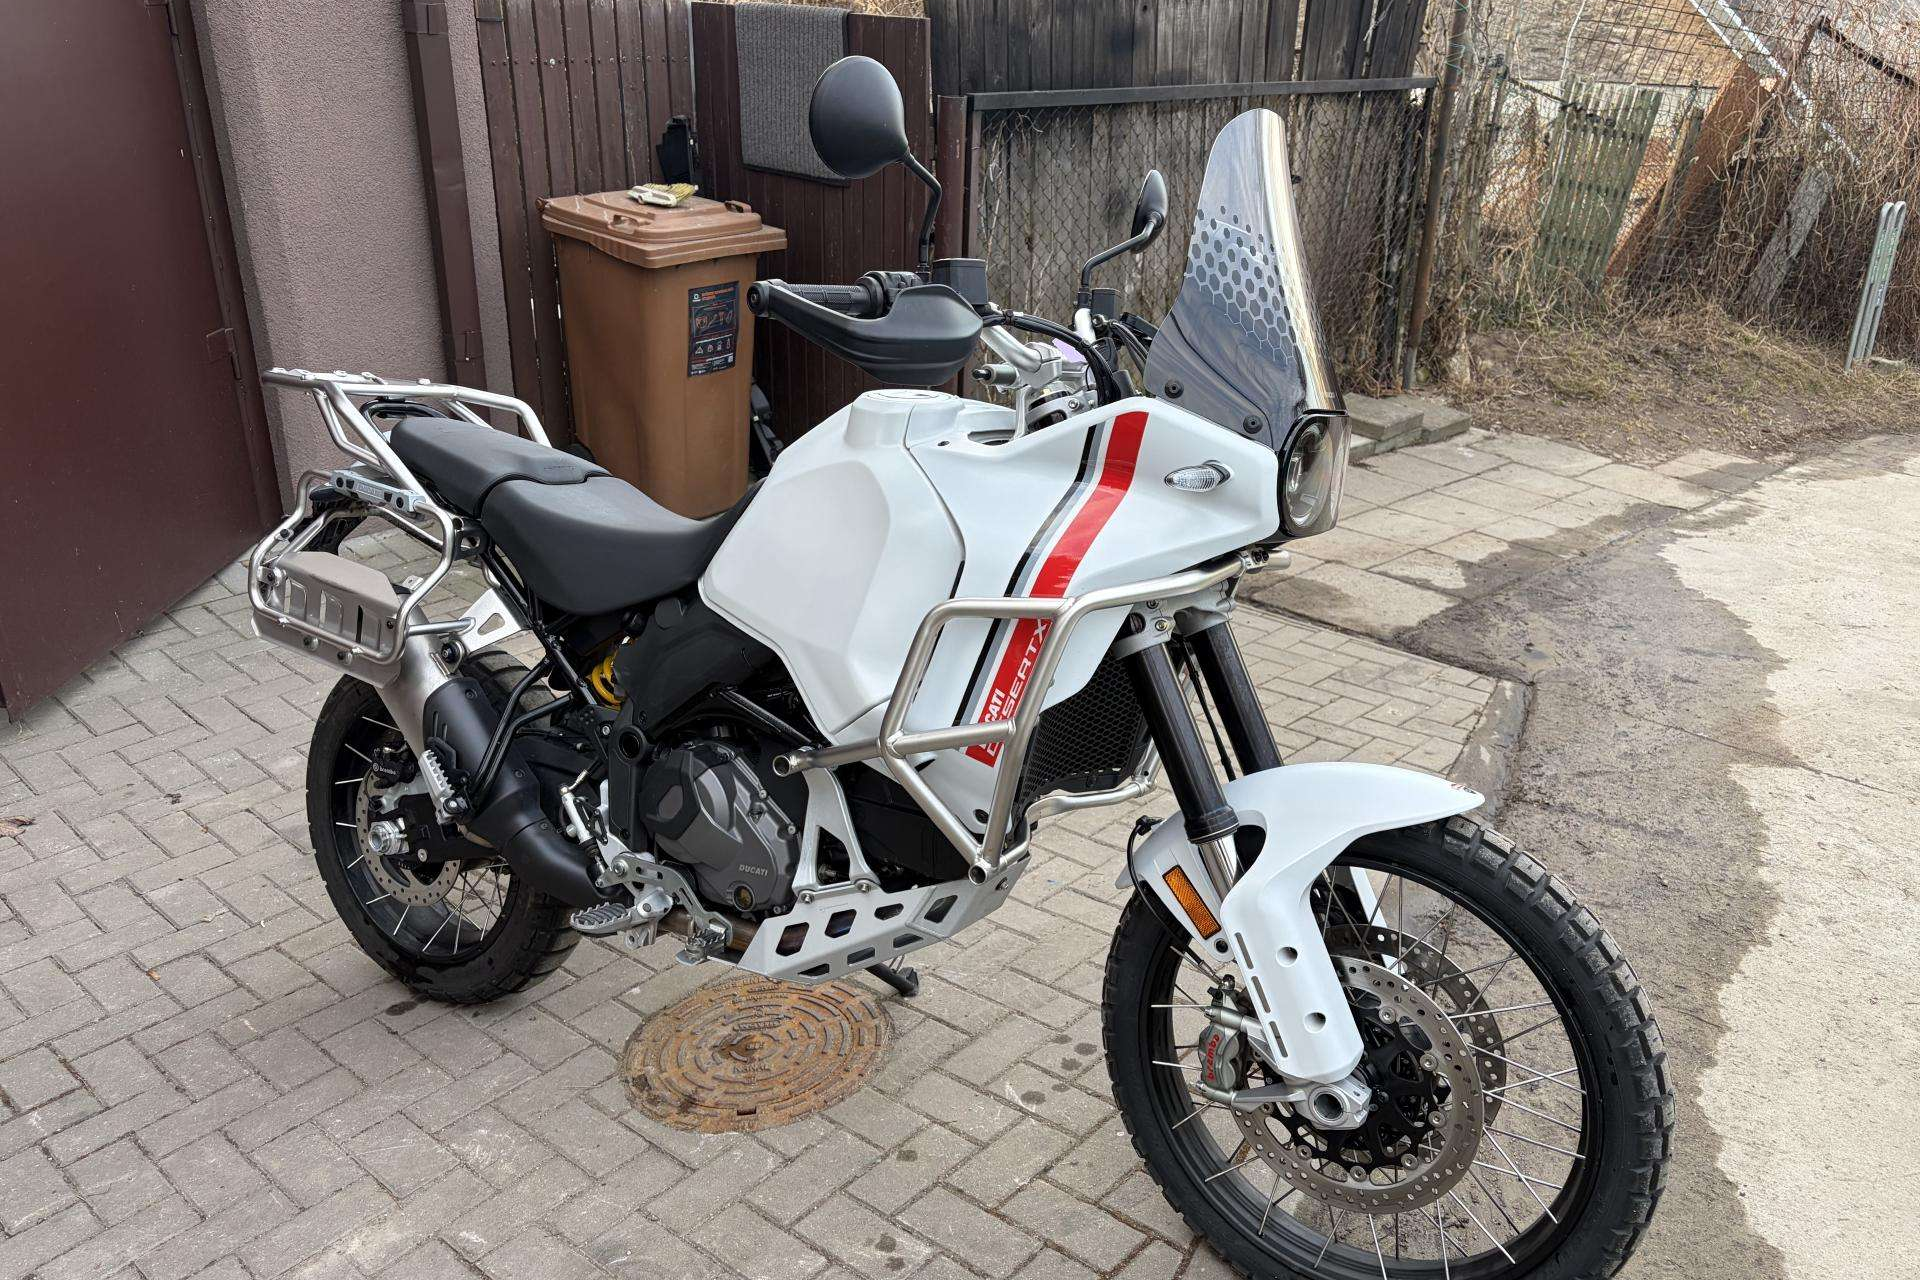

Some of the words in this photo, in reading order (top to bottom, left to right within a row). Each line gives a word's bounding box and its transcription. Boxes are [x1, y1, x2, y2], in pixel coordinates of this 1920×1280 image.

[986, 619, 1047, 757] DSERTX
[738, 864, 769, 876] DUCATI
[1206, 1034, 1220, 1080] brembo
